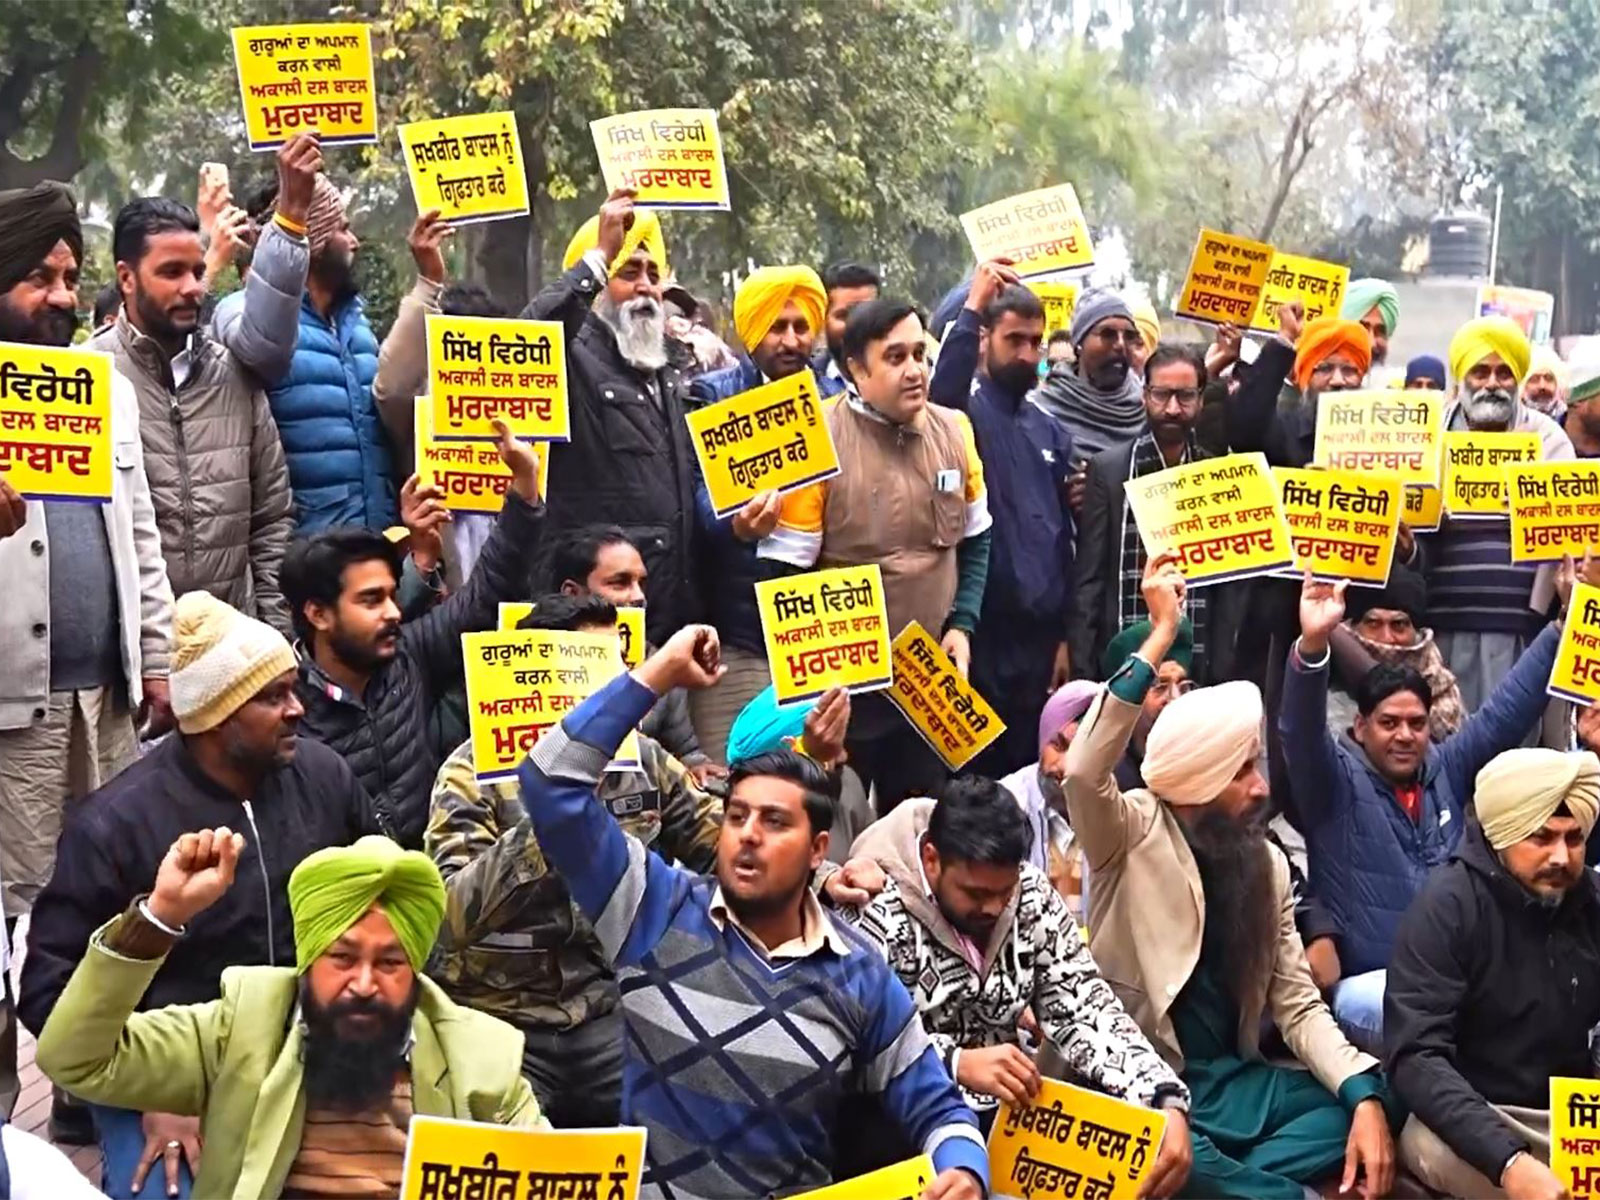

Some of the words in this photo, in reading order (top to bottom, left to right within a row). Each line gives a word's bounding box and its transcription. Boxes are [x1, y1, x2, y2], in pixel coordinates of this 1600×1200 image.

[296, 36, 310, 49] ਦਾ
[277, 59, 308, 72] ਕਰਨ
[312, 54, 341, 71] ਵਾਲੀ
[250, 77, 301, 97] ਅਕਾਲੀ
[306, 81, 328, 94] ਦਲ
[333, 79, 368, 93] ਬਾਦਲ
[261, 102, 362, 135] ਮੁਰਦਾਬਾਦ
[412, 131, 461, 172] ਸੁਖਬੀਰ
[462, 133, 500, 157] ਬਾਦਲ
[501, 123, 514, 164] ਨੂੰ
[657, 149, 677, 161] ਦਲ
[681, 149, 714, 162] ਬਾਦਲ
[1004, 236, 1079, 264] ਰਦਾਬਾਦ
[1298, 273, 1329, 296] ਬਾਦਲ
[1189, 290, 1252, 317] ਮੁਰਦਾਬਾਦ
[442, 331, 482, 362] ਸਿੱਖ
[489, 333, 551, 365] ਵਿਰੋਧੀ
[0, 361, 94, 405] ਵਿਰੋਧੀ
[438, 367, 486, 387] ਅਕਾਲੀ
[491, 373, 513, 388] ਦਲ
[519, 373, 558, 388] ਬਾਦਲ
[44, 413, 102, 435] ਬਾਦਲ
[447, 395, 552, 427] ਮੁਰਦਾਬਾਦ
[701, 411, 753, 460] ਸੁਖਬੀਰ
[754, 398, 798, 431] ਬਾਦਲ
[799, 384, 816, 426] ਨੂੰ
[425, 445, 473, 463] ਅਕਾਲੀ
[478, 450, 500, 465] ਦਲ
[1192, 473, 1205, 486] ਦਾ
[1518, 475, 1548, 499] ਸਿੱਖ
[1552, 472, 1599, 498] ਵਿਰੋਧੀ
[1176, 496, 1208, 512] ਕਰਨ
[1210, 485, 1242, 505] ਵਾਲੀ
[1283, 480, 1322, 508] ਸਿੱਖ
[1329, 483, 1389, 517] ਵਿਰੋਧੀ
[1516, 502, 1552, 518] ਅਕਾਲੀ
[1556, 505, 1573, 517] ਦਲ
[1207, 513, 1232, 530] ਦਲ
[1235, 505, 1276, 523] ਬਾਦਲ
[1286, 512, 1322, 529] ਕਾਲੀ
[1327, 518, 1349, 532] ਦਲ
[1354, 522, 1390, 538] ਬਾਦਲ
[1291, 536, 1380, 566] ਰਦਾਬਾਦ
[1524, 524, 1599, 552] ਮੁਰਦਾਬਾਦ
[774, 589, 816, 622] ਸਿੱਖ
[821, 578, 873, 612] ਵਿਰੋਧੀ
[774, 619, 824, 645] ਅਕਾਲੀ
[828, 621, 848, 636] ਦਲ
[538, 644, 553, 658] ਦਾ
[787, 640, 879, 686] ਮੁਰਦਾਬਾਦ
[514, 669, 552, 684] ਕਰਨ
[556, 665, 590, 684] ਵਾਲੀ
[909, 638, 942, 676] ਸਿੱਖ
[938, 674, 989, 733] ਵਿਰੋਧੀ
[479, 689, 542, 716] ਅਕਾਲੀ
[1077, 1121, 1131, 1161] ਬਾਦਲ
[1128, 1126, 1151, 1180] ਨੂੰ
